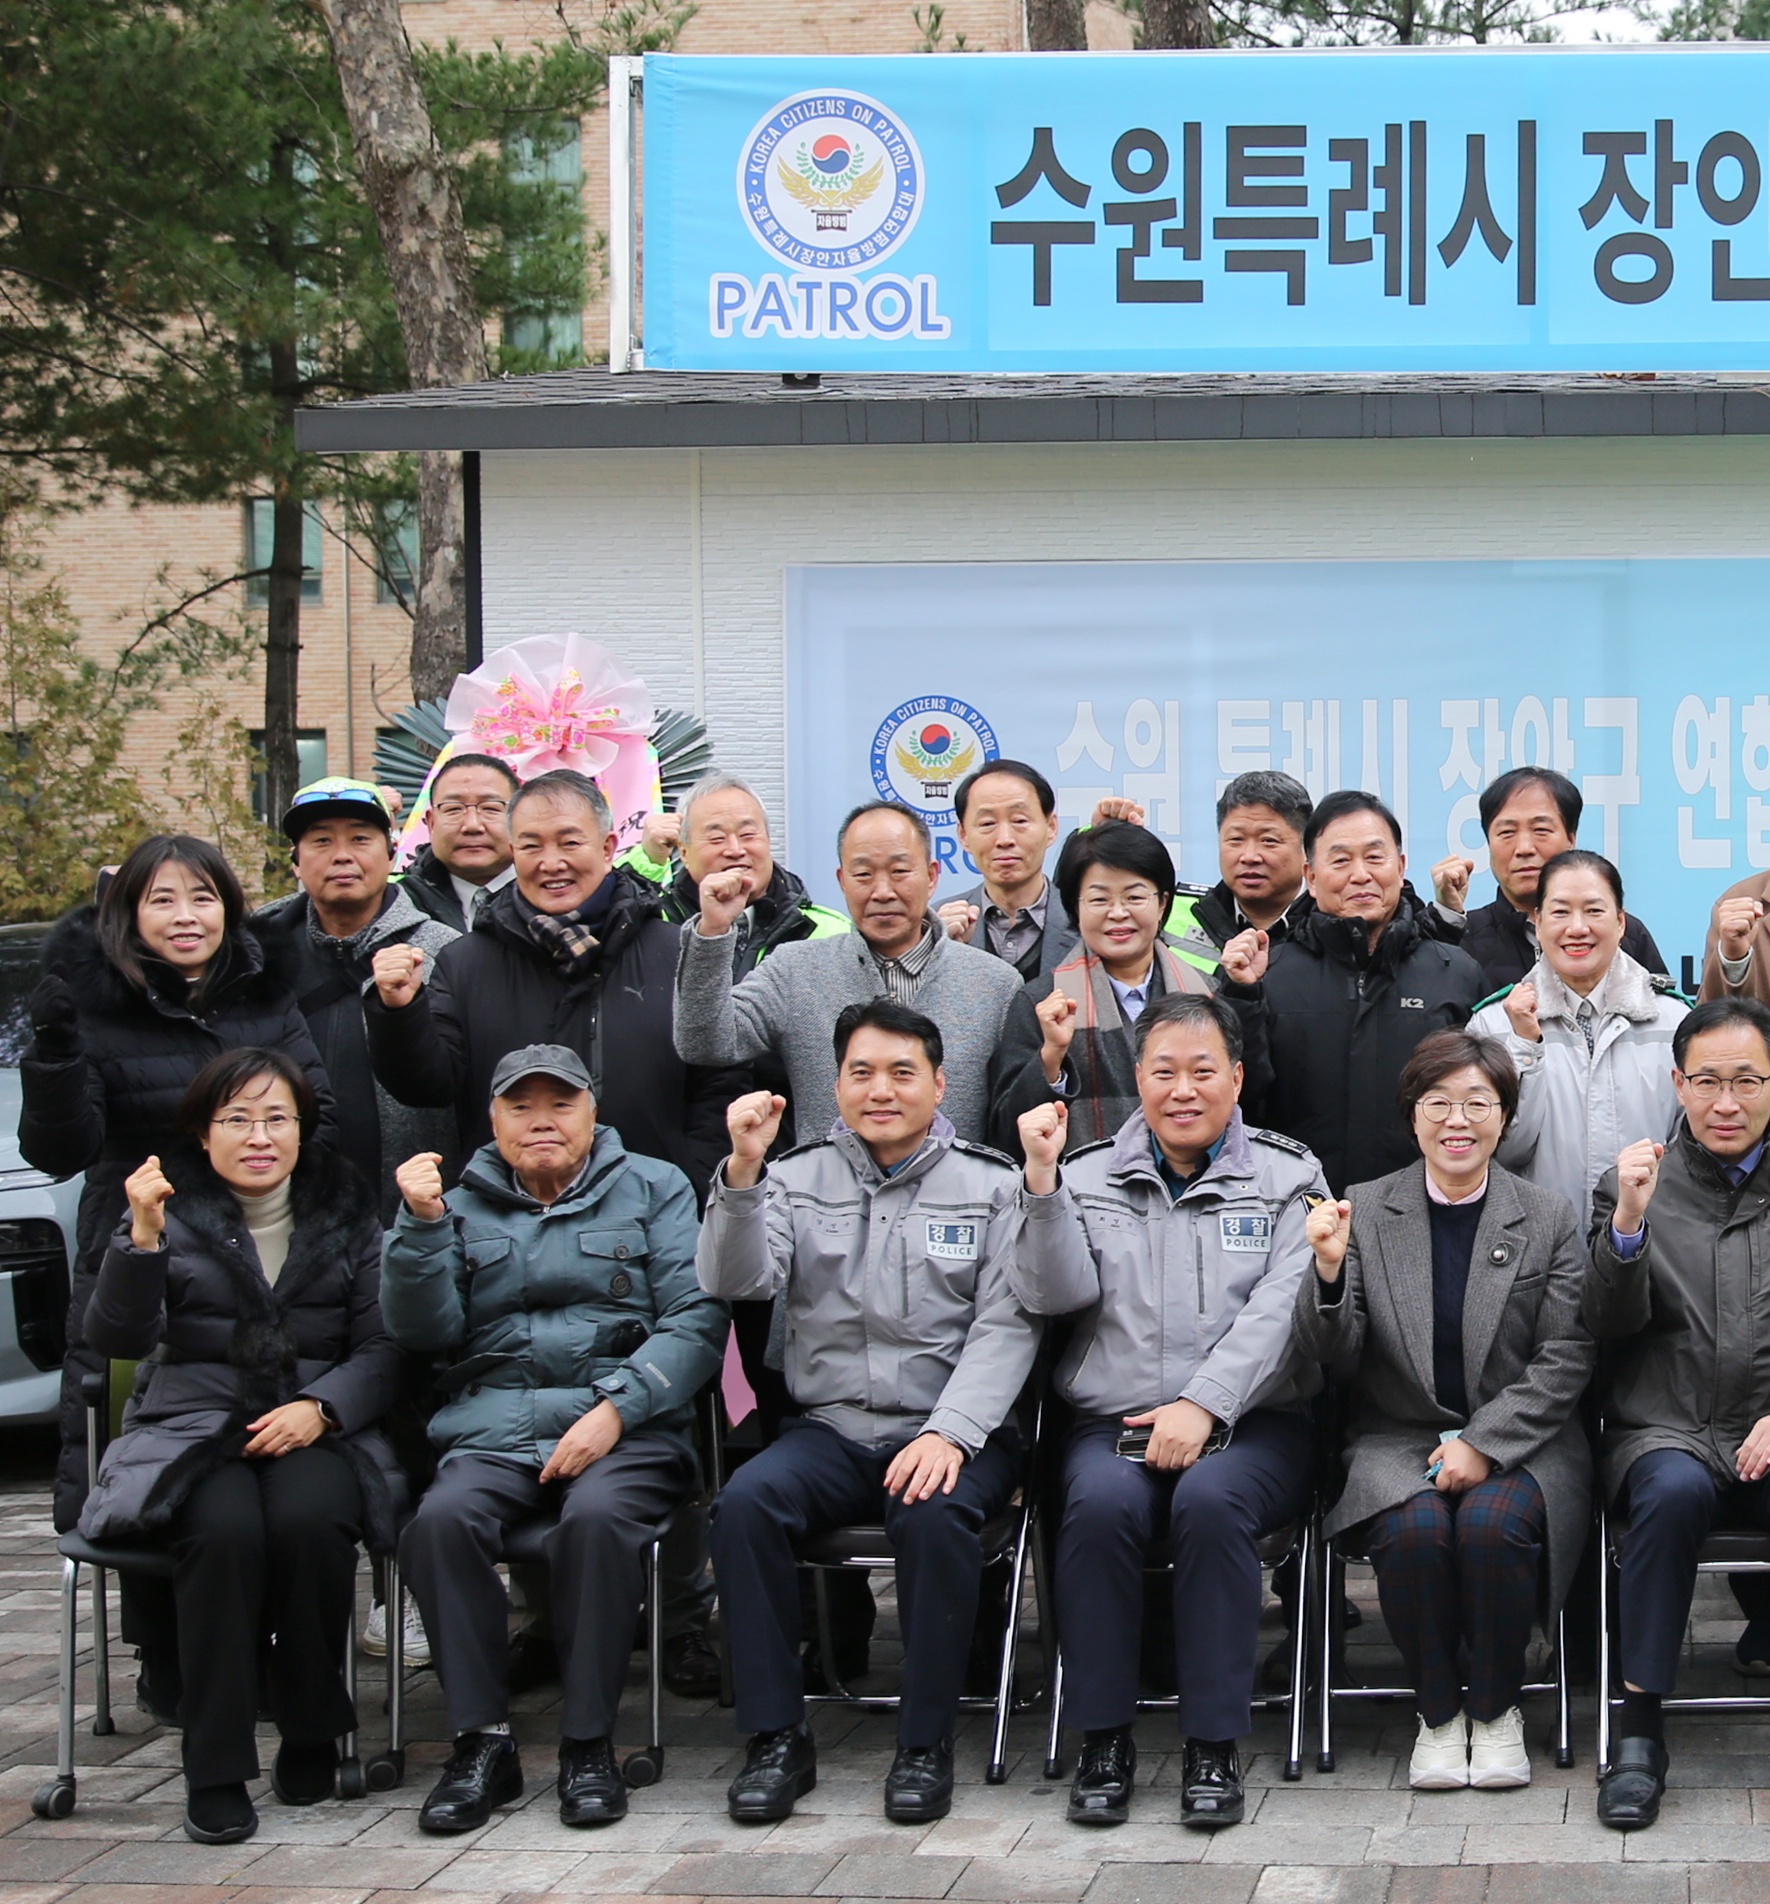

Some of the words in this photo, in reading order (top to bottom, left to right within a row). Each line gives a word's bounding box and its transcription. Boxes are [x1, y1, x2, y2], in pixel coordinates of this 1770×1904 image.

[750, 127, 782, 174] KOREA
[780, 99, 846, 128] CITIZENS
[851, 104, 874, 125] ON
[873, 119, 911, 173] PATROL
[990, 119, 1536, 307] 수원특례시
[718, 281, 943, 332] PATROL
[873, 720, 898, 755] KOREA
[896, 697, 947, 720] CITIZENS
[950, 702, 968, 718] ON
[967, 711, 997, 754] PATROL
[1401, 997, 1424, 1008] K2
[931, 1225, 972, 1243] 경찰
[1226, 1218, 1266, 1236] 경찰
[931, 1244, 972, 1255] POLICE
[1226, 1238, 1266, 1248] POLICE
